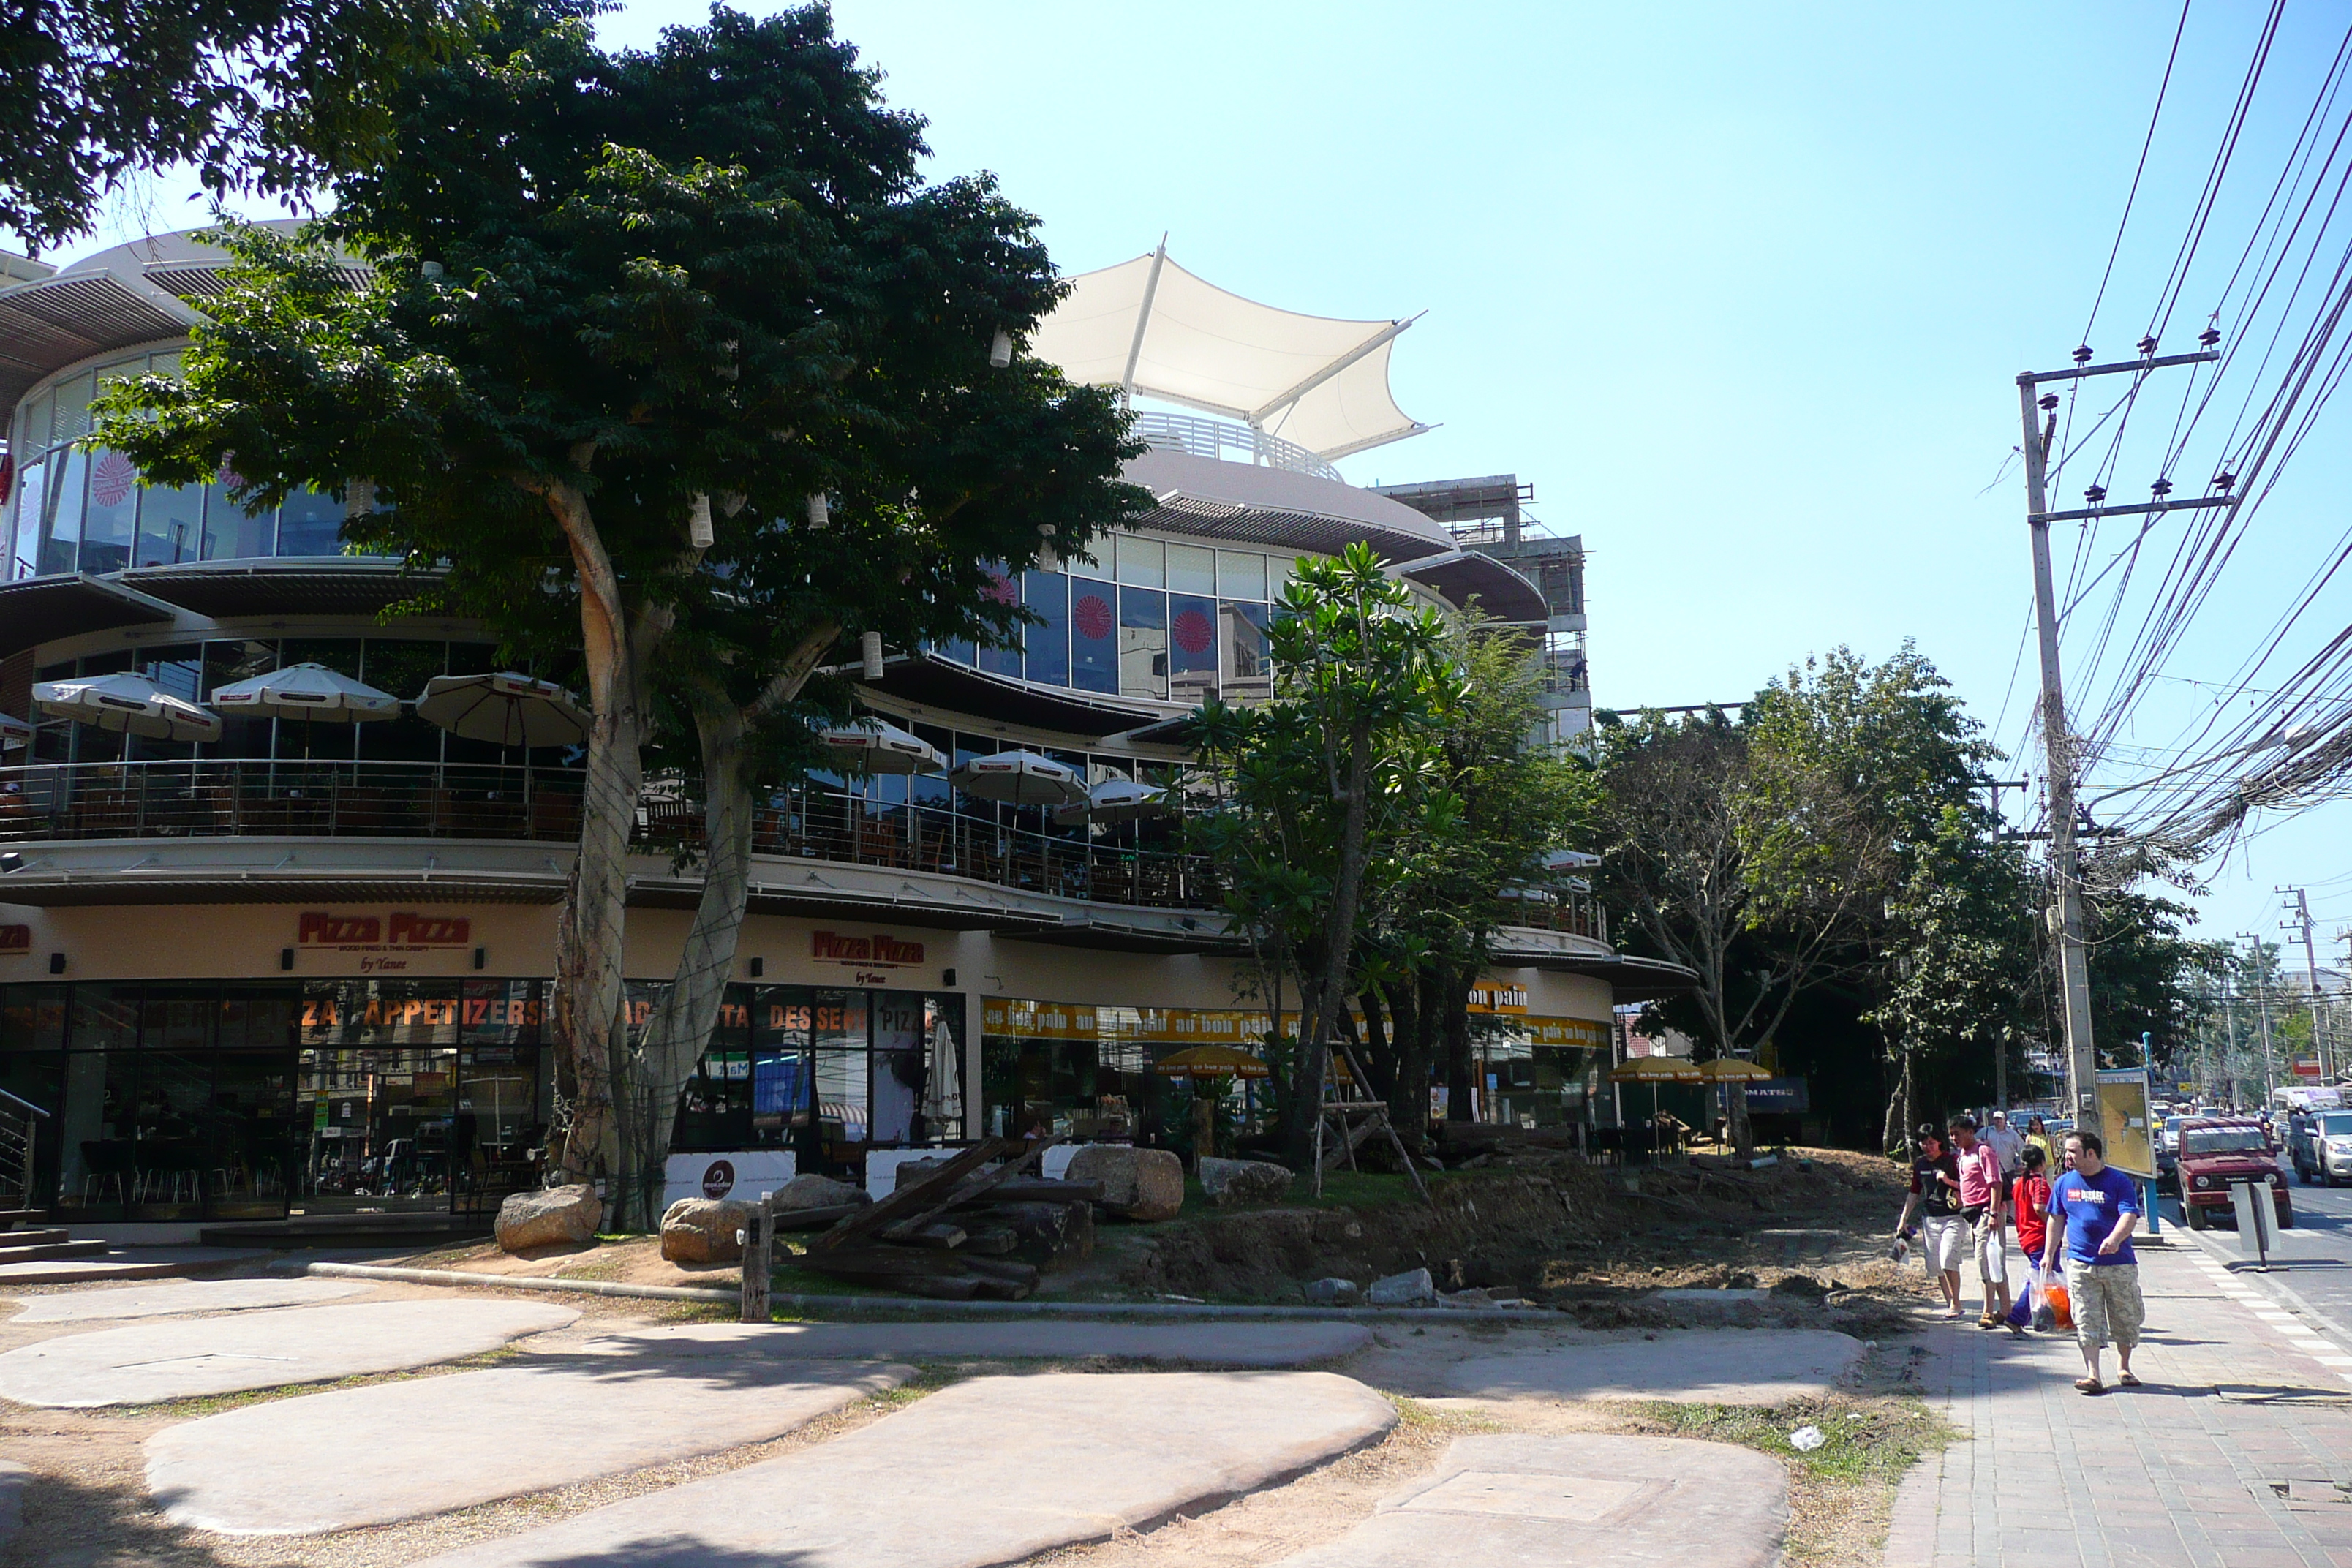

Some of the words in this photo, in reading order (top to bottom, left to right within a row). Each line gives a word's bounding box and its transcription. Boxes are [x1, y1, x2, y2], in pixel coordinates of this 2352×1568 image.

[299, 913, 380, 943] Pizza
[388, 913, 470, 943] Pizza
[813, 930, 870, 959] Pizza
[874, 935, 924, 962] Pizza
[361, 957, 373, 973] by
[376, 957, 407, 970] Yanee
[856, 971, 864, 985] by
[1467, 989, 1488, 1005] on
[1493, 984, 1527, 1011] pain
[363, 999, 546, 1026] APPETIZERS
[770, 1004, 868, 1030] DESSERT
[1037, 1009, 1068, 1033] pain
[1076, 1014, 1093, 1030] au
[1175, 1018, 1195, 1033] au
[1202, 1014, 1233, 1033] bon
